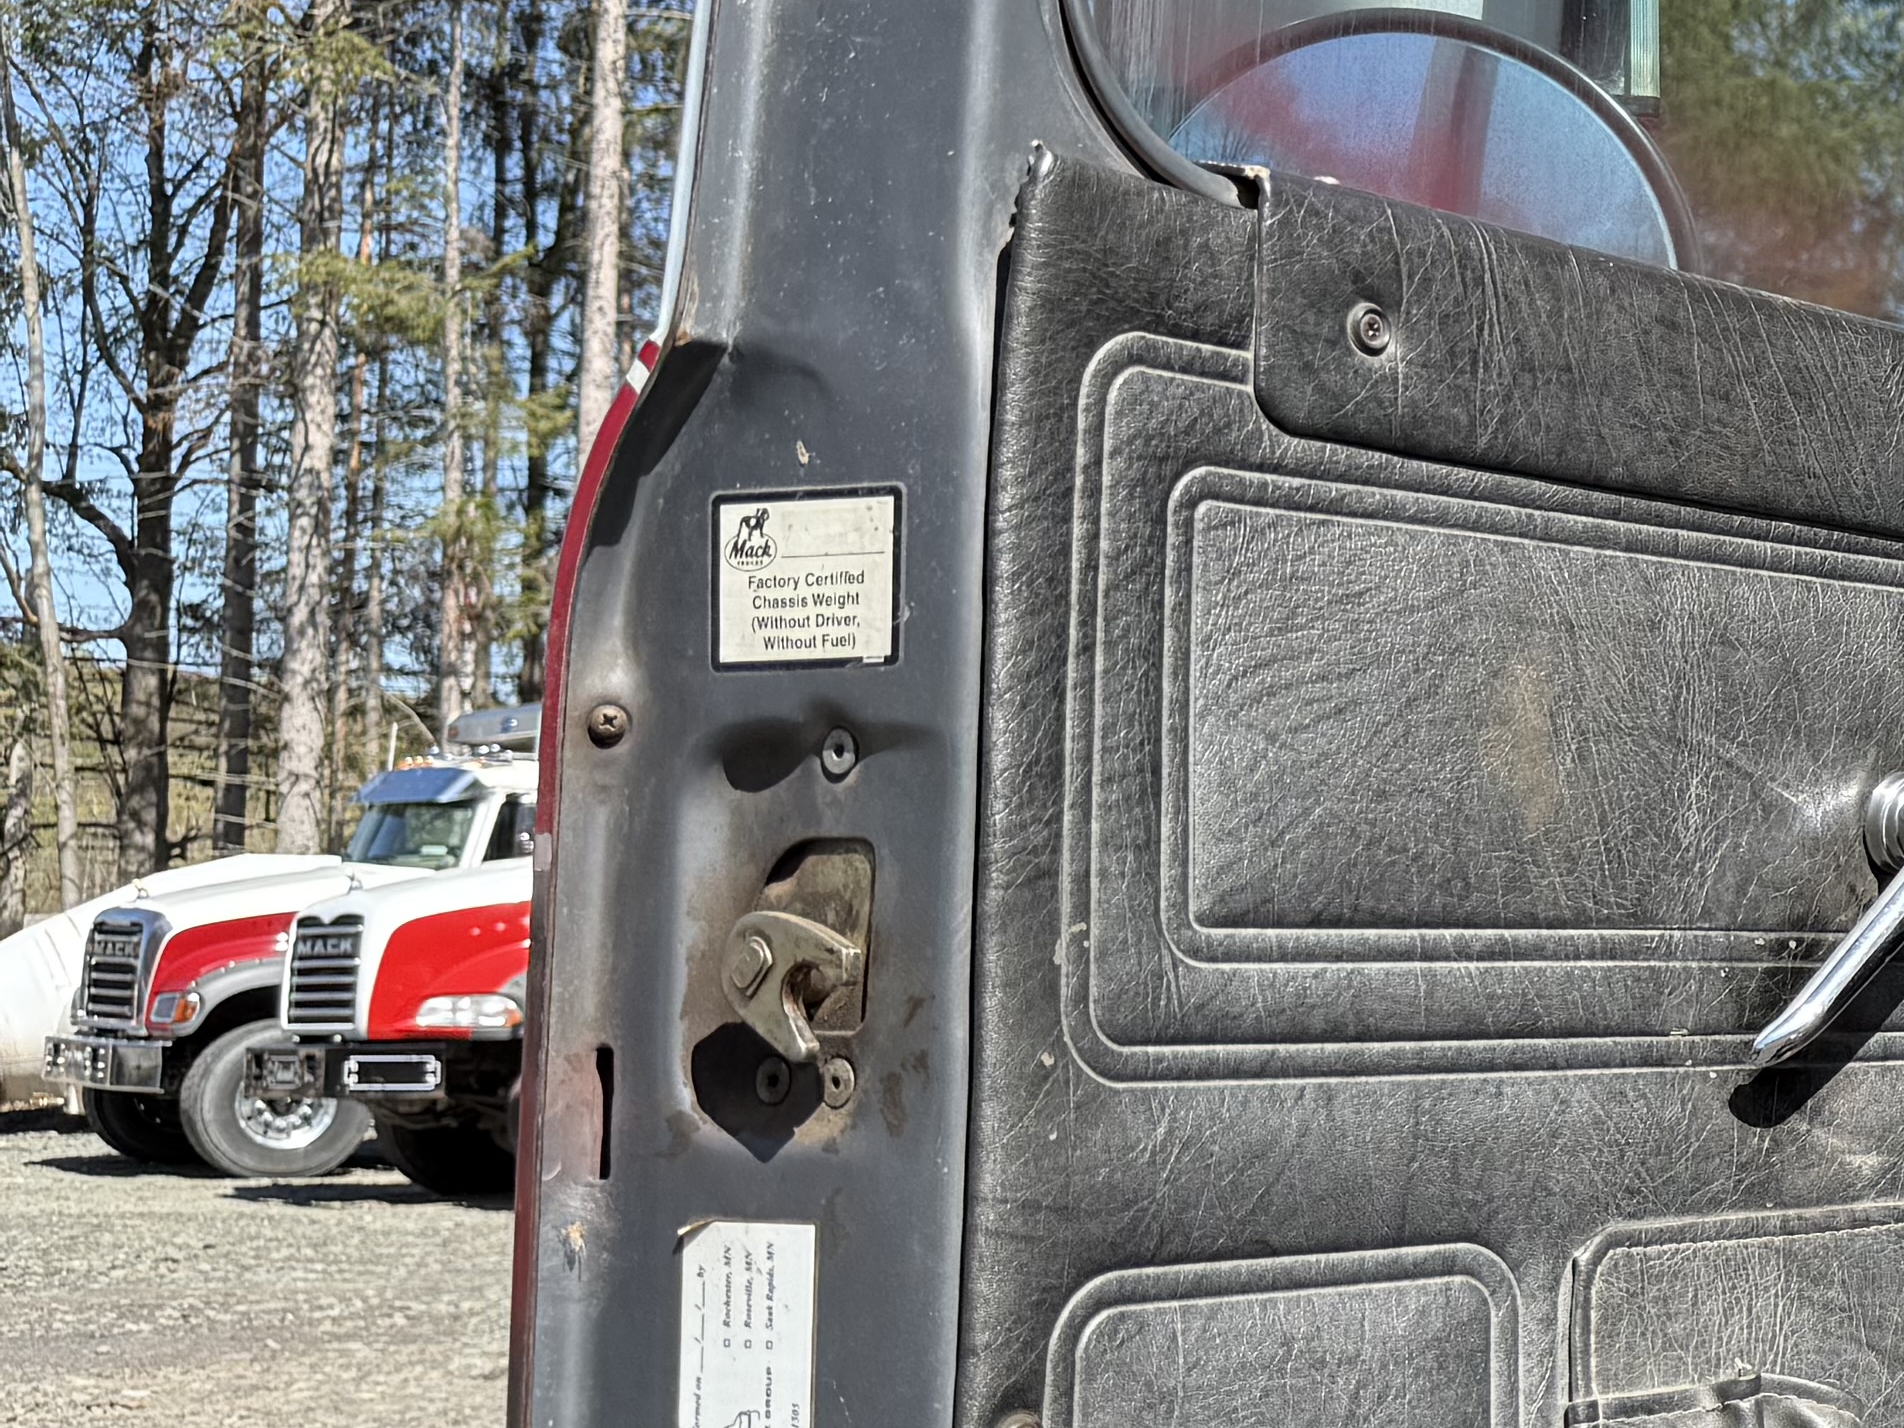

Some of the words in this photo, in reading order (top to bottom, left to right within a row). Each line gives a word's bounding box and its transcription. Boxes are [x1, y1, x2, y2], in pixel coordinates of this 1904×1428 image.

[729, 539, 773, 560] Mack
[748, 575, 800, 591] Factory
[805, 569, 866, 587] Certified
[752, 595, 808, 610] Chassis
[812, 592, 860, 609] Weight
[751, 615, 811, 633] (Without
[815, 613, 860, 628] Driver,
[763, 636, 817, 651] Without
[822, 633, 856, 649] Fuel)
[94, 940, 134, 956] MACK
[297, 938, 352, 955] MACK
[765, 1366, 773, 1419] GROUP
